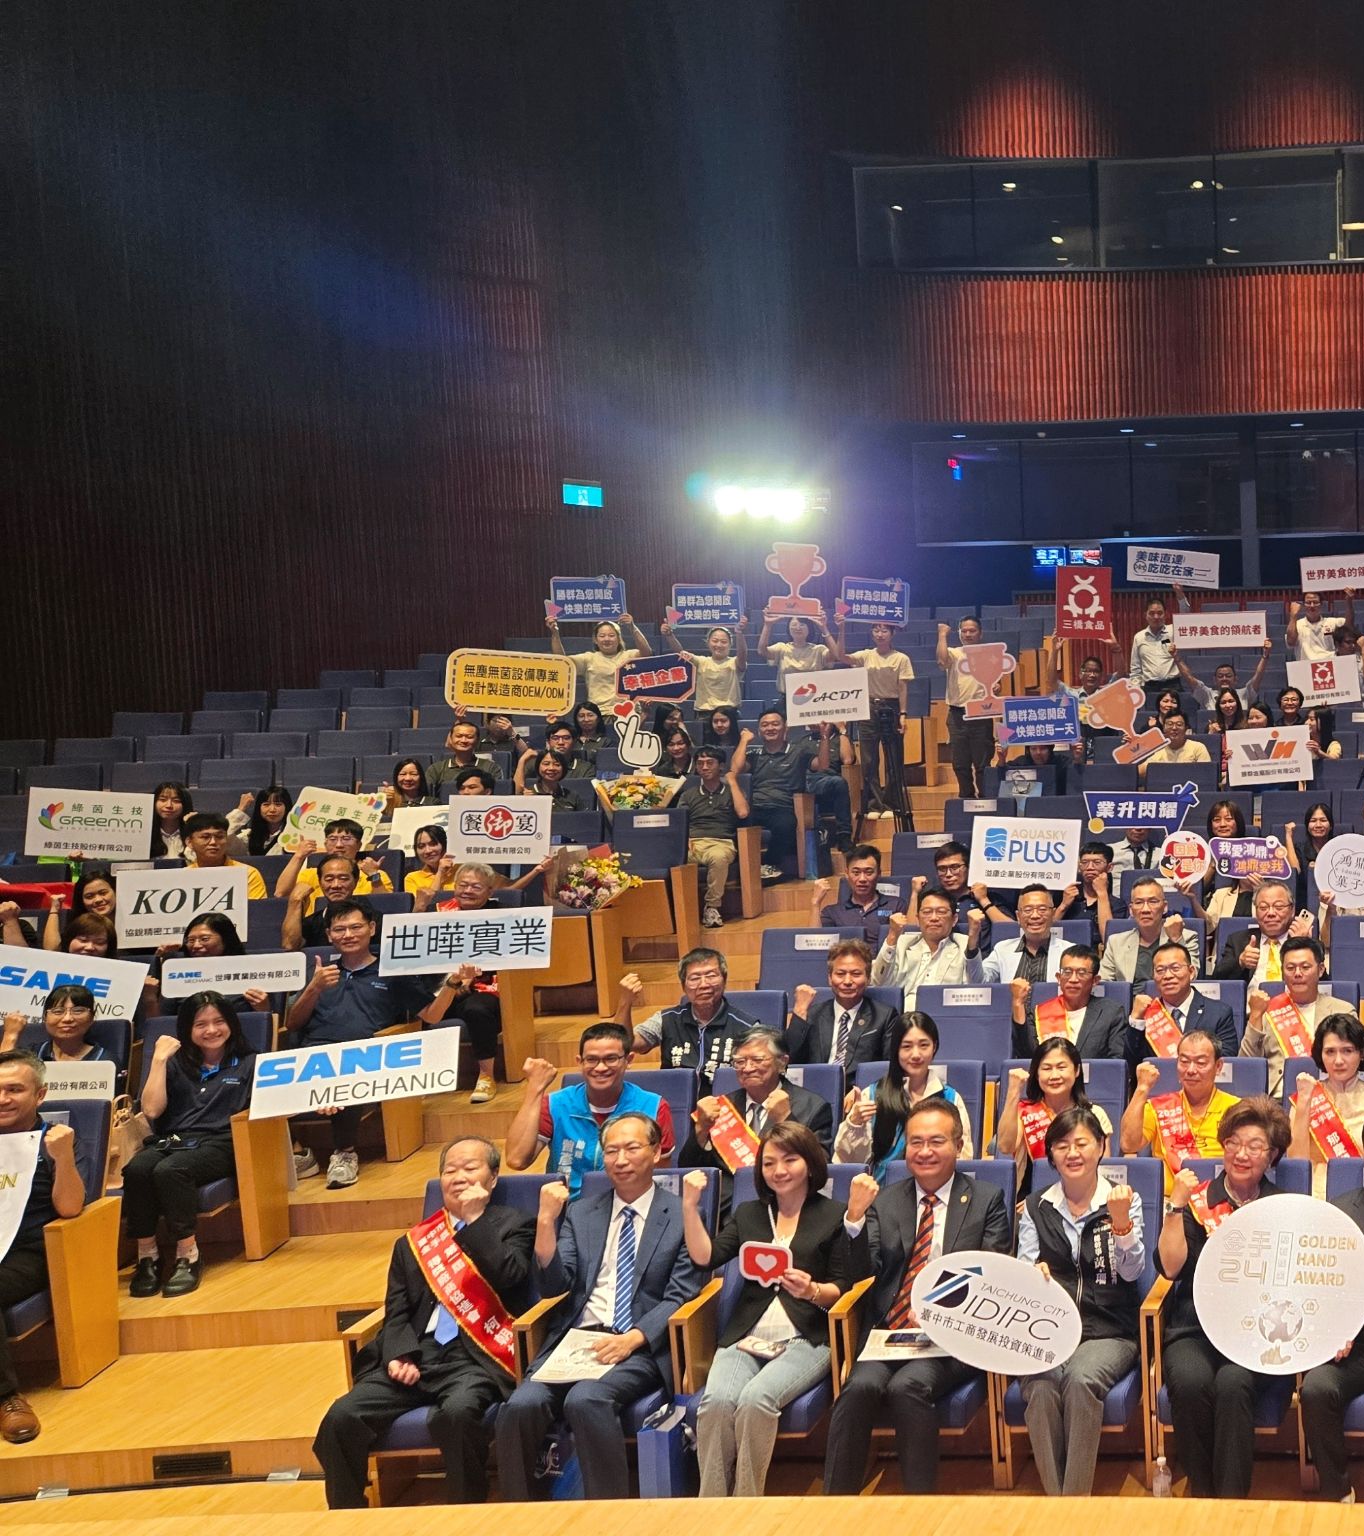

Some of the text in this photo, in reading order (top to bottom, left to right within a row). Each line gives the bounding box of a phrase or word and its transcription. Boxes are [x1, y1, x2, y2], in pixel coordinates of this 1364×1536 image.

[1136, 550, 1183, 566] 美味直達
[556, 588, 614, 601] 勝群為您開啟
[677, 595, 732, 607] 勝群為您開啟
[846, 589, 898, 603] 勝群為您開啟
[564, 603, 621, 614] 快樂的每一天
[684, 609, 738, 620] 快樂的每一天
[852, 603, 904, 618] 快樂的每一天
[1063, 619, 1105, 631] 三橋食品
[1178, 624, 1262, 637] 世界美食的領航者
[463, 663, 559, 684] 無塵無菌設備專業
[622, 667, 688, 691] 幸福企業
[463, 681, 565, 700] 設計製造商OEM/ODM
[814, 688, 863, 704] ACDT
[1009, 707, 1067, 723] 勝群為您開啟
[1016, 722, 1075, 738] 快樂的每一天
[1096, 801, 1178, 819] 業升閃耀
[1010, 829, 1067, 838] AQUASKY
[466, 846, 531, 855] 餐御宴食品有限公司
[1008, 840, 1066, 864] PLUS
[1218, 842, 1268, 860] 我愛鴻鼎
[1235, 859, 1284, 874] 鴻鼎愛我
[1336, 875, 1363, 890] 菓子
[130, 886, 235, 916] KOVA
[387, 918, 547, 960] 世曄實業
[0, 965, 112, 998] SANE
[167, 971, 202, 979] SANE
[215, 969, 300, 982] 世曄實業股份有限公司
[30, 994, 125, 1017] MNIC
[256, 1038, 422, 1089] SANE
[309, 1069, 455, 1106] MECHANIC
[1299, 1235, 1357, 1249] GOLDEN
[1296, 1253, 1338, 1267] HAND
[1293, 1271, 1345, 1286] AWARD
[980, 1283, 1070, 1319] TAICHUNG CITY
[920, 1308, 1056, 1364] 臺中市工商發展投資策進會
